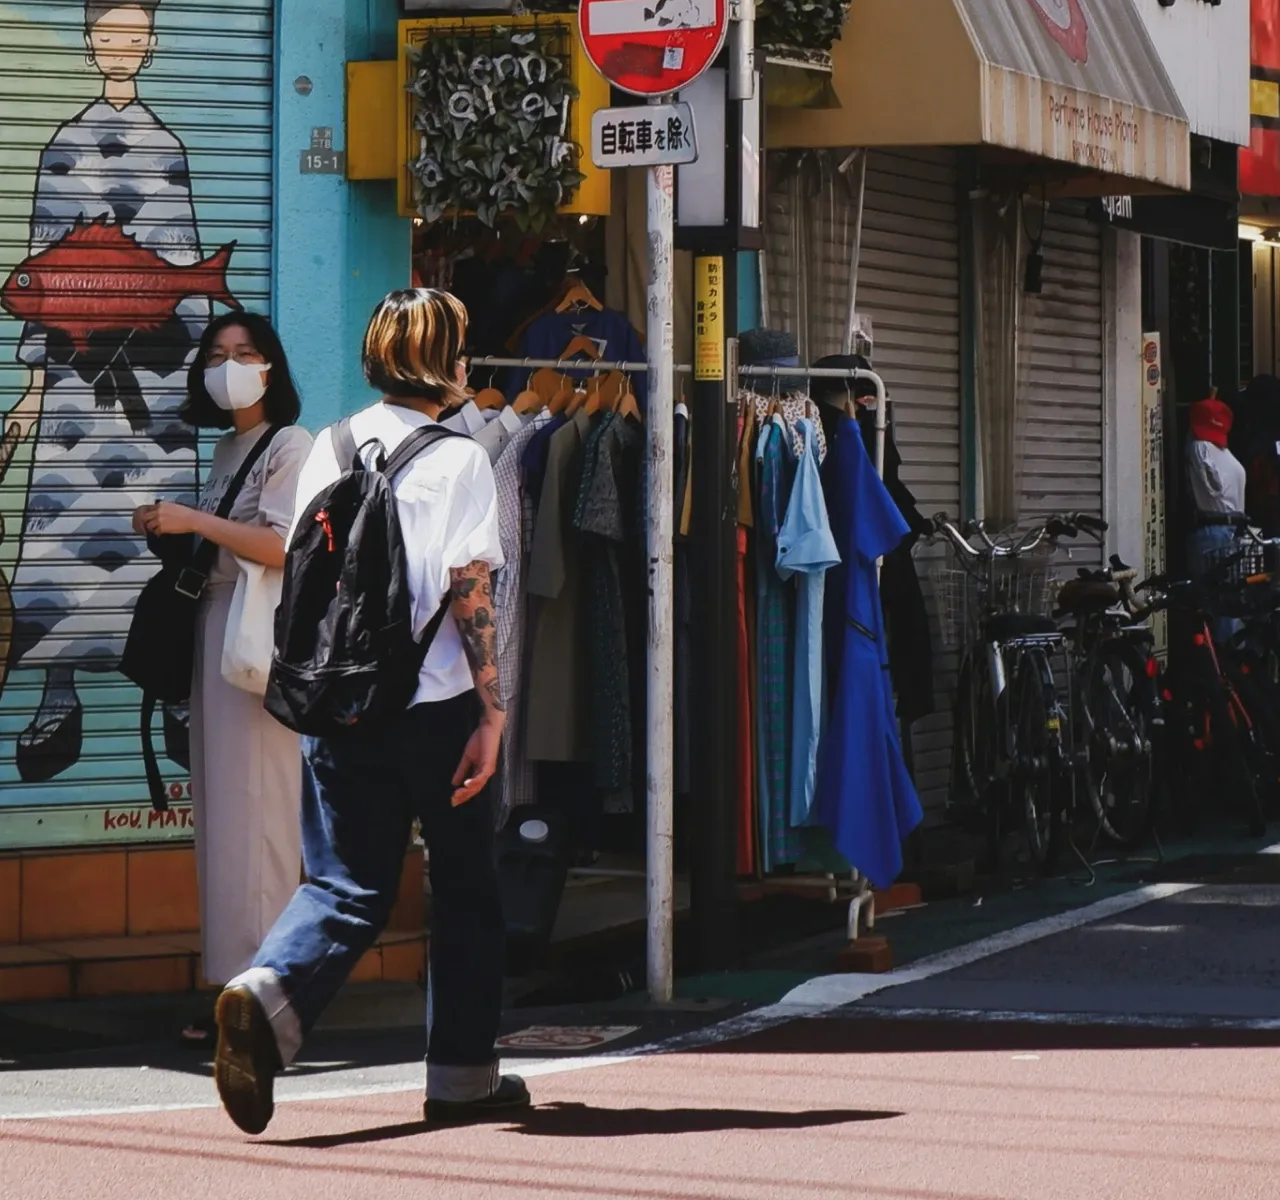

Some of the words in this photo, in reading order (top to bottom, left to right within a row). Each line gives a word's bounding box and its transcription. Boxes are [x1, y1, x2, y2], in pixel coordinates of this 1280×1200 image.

[601, 116, 691, 155] 自転車を除く
[306, 154, 338, 169] 15-1
